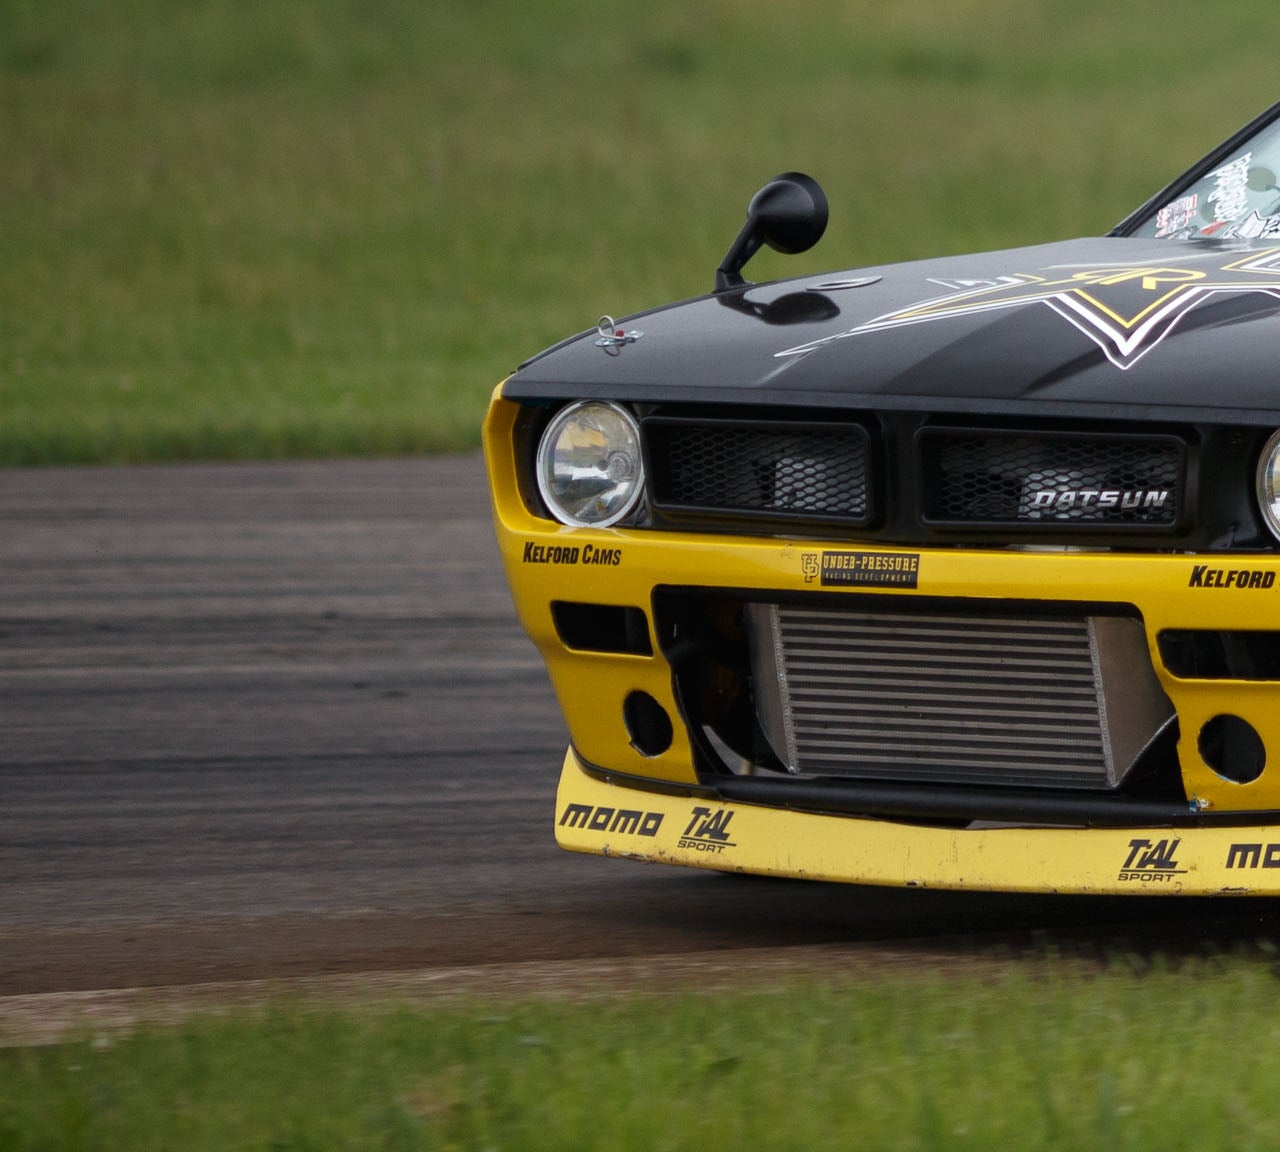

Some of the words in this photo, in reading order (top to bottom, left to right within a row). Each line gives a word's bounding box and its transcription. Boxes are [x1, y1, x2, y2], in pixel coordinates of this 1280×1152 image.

[1033, 491, 1168, 509] DATSUN
[522, 542, 579, 565] KELFORD
[581, 544, 622, 566] CAMS
[823, 555, 918, 572] UNDER-PRESSURE
[1188, 565, 1277, 589] KELFORD
[677, 839, 728, 854] SPORT
[1117, 873, 1176, 882] SPORT
